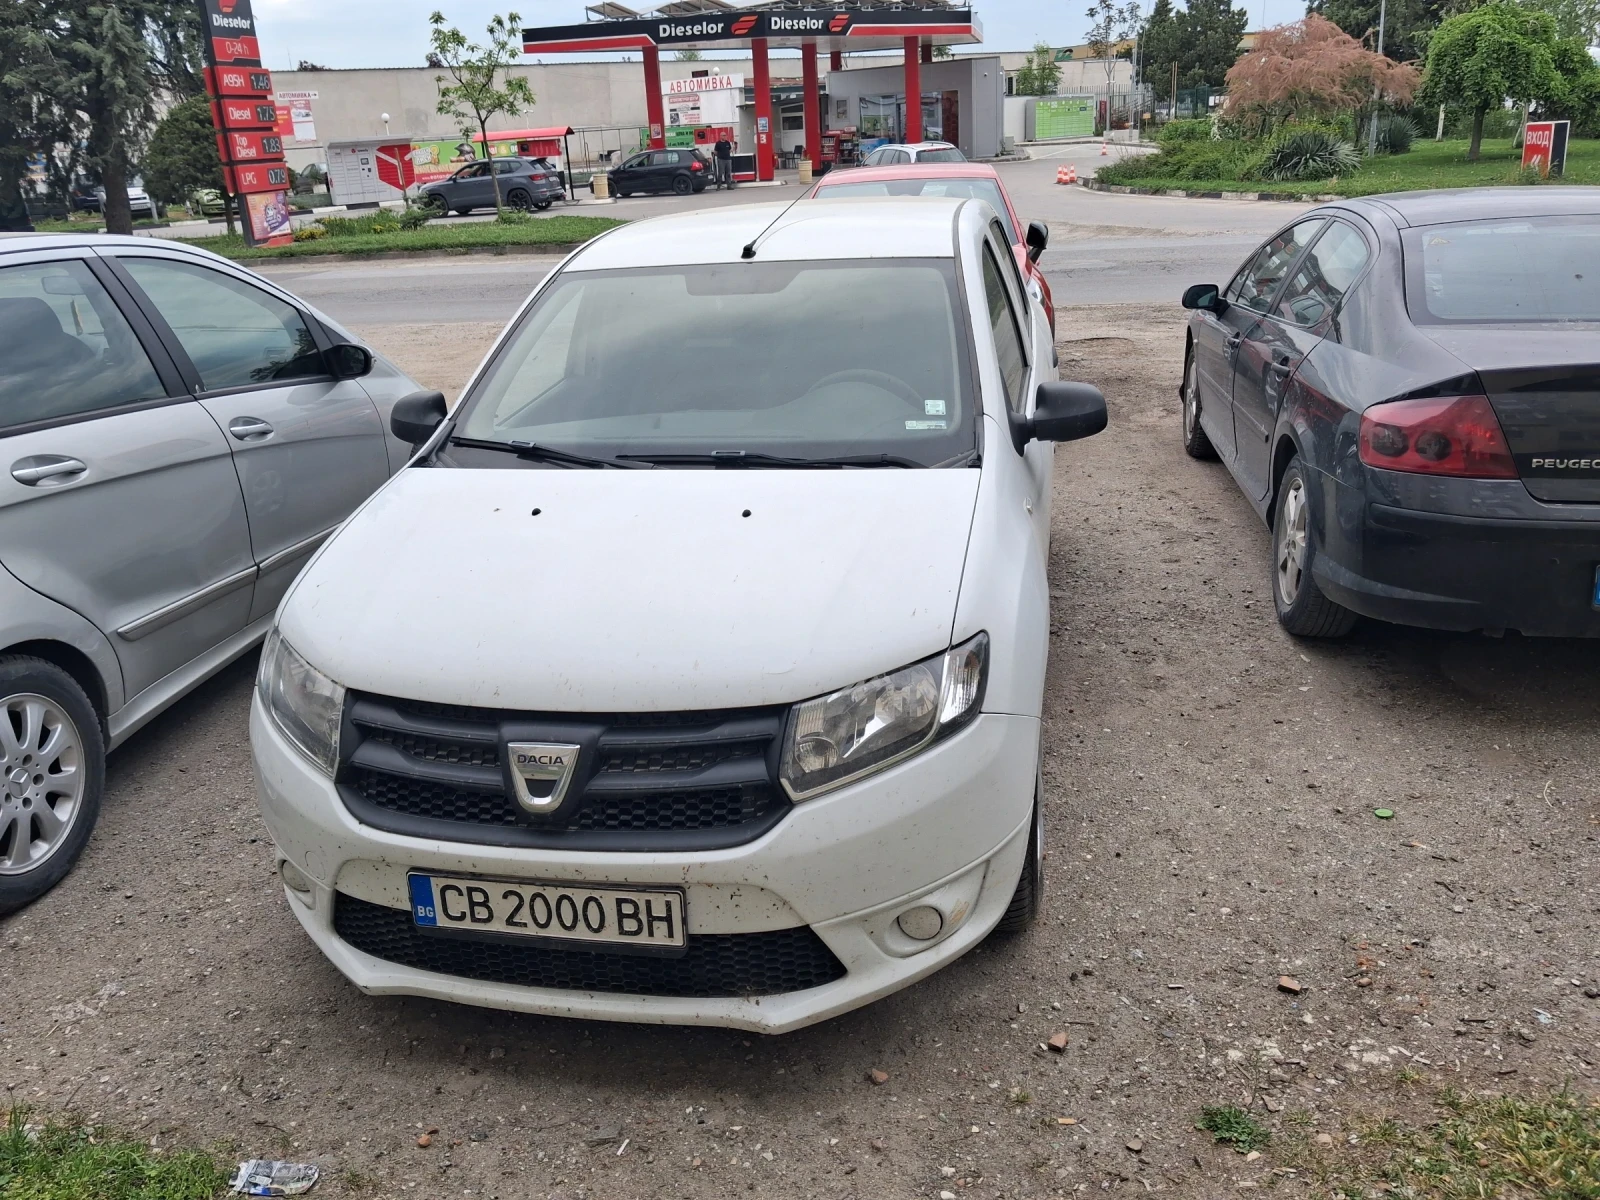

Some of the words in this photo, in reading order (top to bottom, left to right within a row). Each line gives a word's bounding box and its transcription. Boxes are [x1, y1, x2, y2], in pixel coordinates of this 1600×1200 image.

[212, 13, 251, 29] Dieselor
[771, 17, 824, 30] Dieselor
[659, 21, 724, 37] Dieselor
[225, 41, 243, 55] 0-24
[251, 74, 270, 89] 1.46
[670, 76, 733, 93] АВТОМИВКА
[229, 107, 251, 120] Diesel
[257, 106, 275, 121] 1.75
[234, 134, 248, 148] Top
[760, 134, 767, 144] 3
[1526, 131, 1550, 148] ВХОД
[236, 146, 257, 158] Diesel
[263, 138, 281, 153] 1.83
[241, 172, 257, 185] LPG
[517, 754, 564, 766] DACIA
[416, 905, 434, 918] BG
[439, 884, 494, 924] CB
[501, 889, 606, 934] 2000
[615, 897, 675, 939] BH
